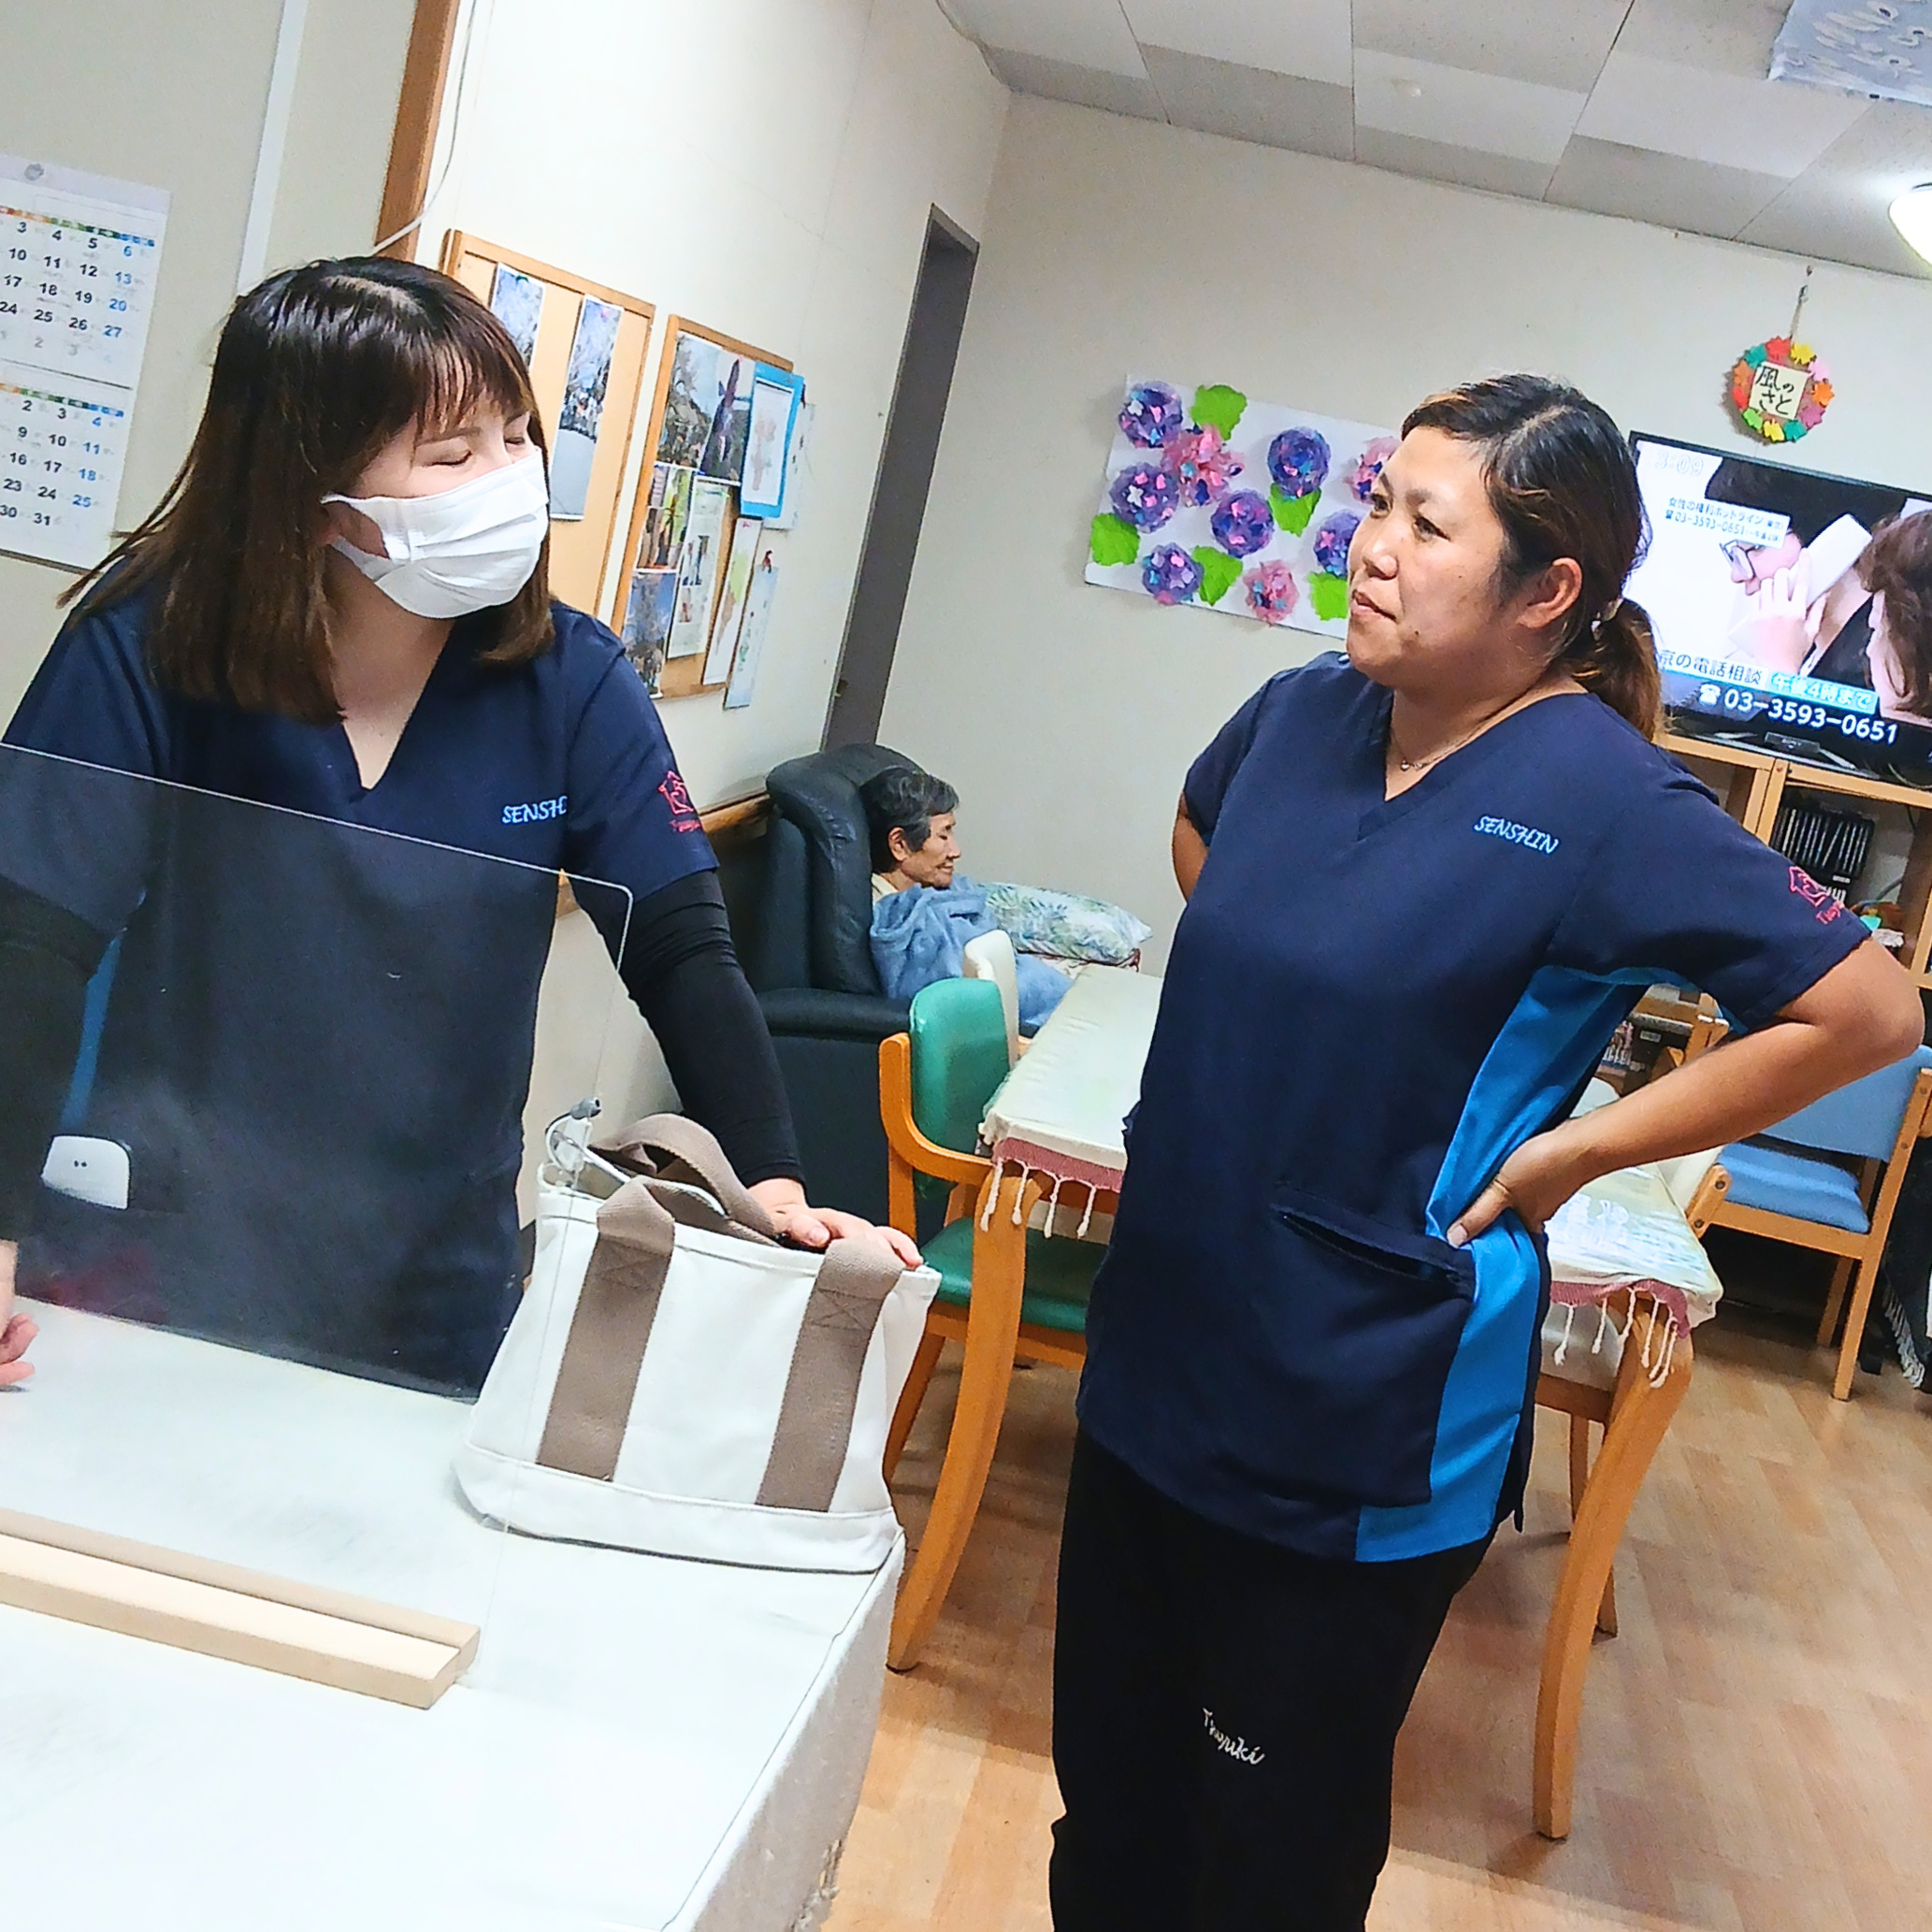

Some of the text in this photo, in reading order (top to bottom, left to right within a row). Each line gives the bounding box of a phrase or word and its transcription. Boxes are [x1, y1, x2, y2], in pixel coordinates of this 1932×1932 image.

[18, 222, 132, 257] 3 4 5 6
[9, 248, 132, 284] 10 11 12 13
[4, 275, 22, 287] 17
[39, 282, 58, 296] 18
[75, 291, 93, 304] 19
[108, 298, 127, 311] 20
[0, 301, 123, 338] 24 25 26 27
[22, 400, 101, 426] 2 3 4
[18, 426, 27, 438] 9
[48, 434, 66, 447] 10
[83, 442, 100, 454] 11
[9, 453, 96, 481] 16 17 18
[3, 478, 92, 508] 23 24 25
[0, 505, 50, 526] 30 31
[1724, 688, 1898, 744] 03-3593-0651
[502, 796, 569, 824] SENSH
[1474, 815, 1560, 854] SENSHIN
